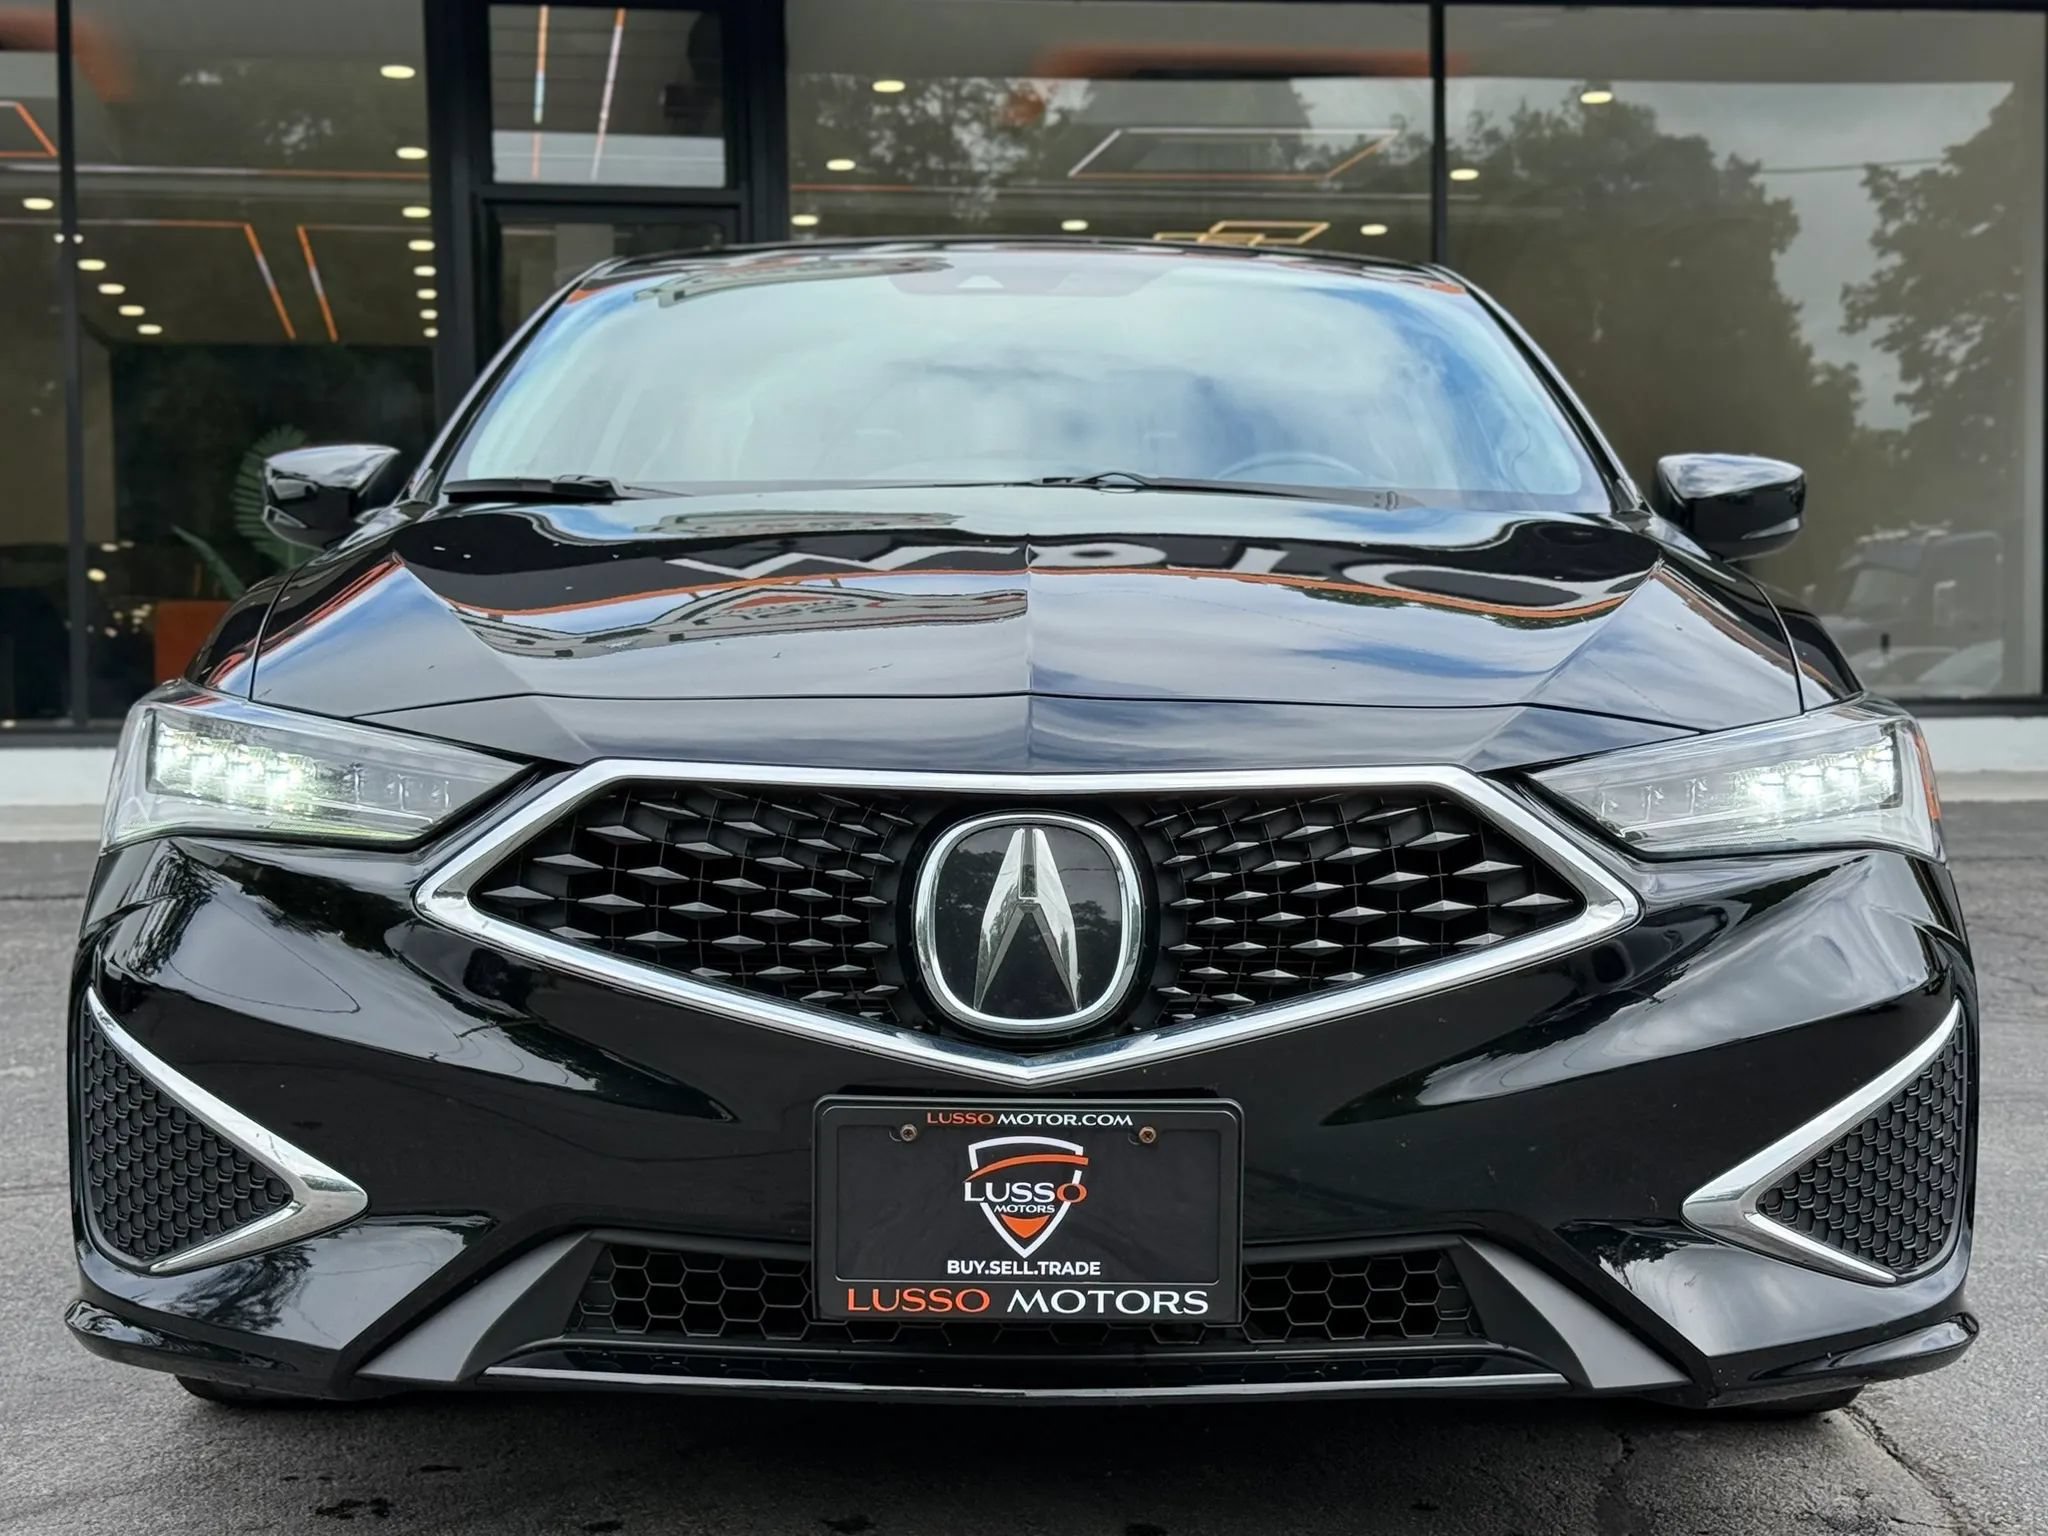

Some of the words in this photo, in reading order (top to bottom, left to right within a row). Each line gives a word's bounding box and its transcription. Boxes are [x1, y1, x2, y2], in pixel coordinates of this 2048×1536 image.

[927, 1112, 994, 1126] LUSSO
[997, 1112, 1133, 1126] MOTOR.COM
[964, 1181, 1088, 1204] LUSSO
[993, 1204, 1056, 1214] MOTORS
[947, 1260, 1101, 1276] BUY.SELL.TRADE
[847, 1287, 990, 1313] LUSSO
[1006, 1288, 1209, 1314] MOTORS
